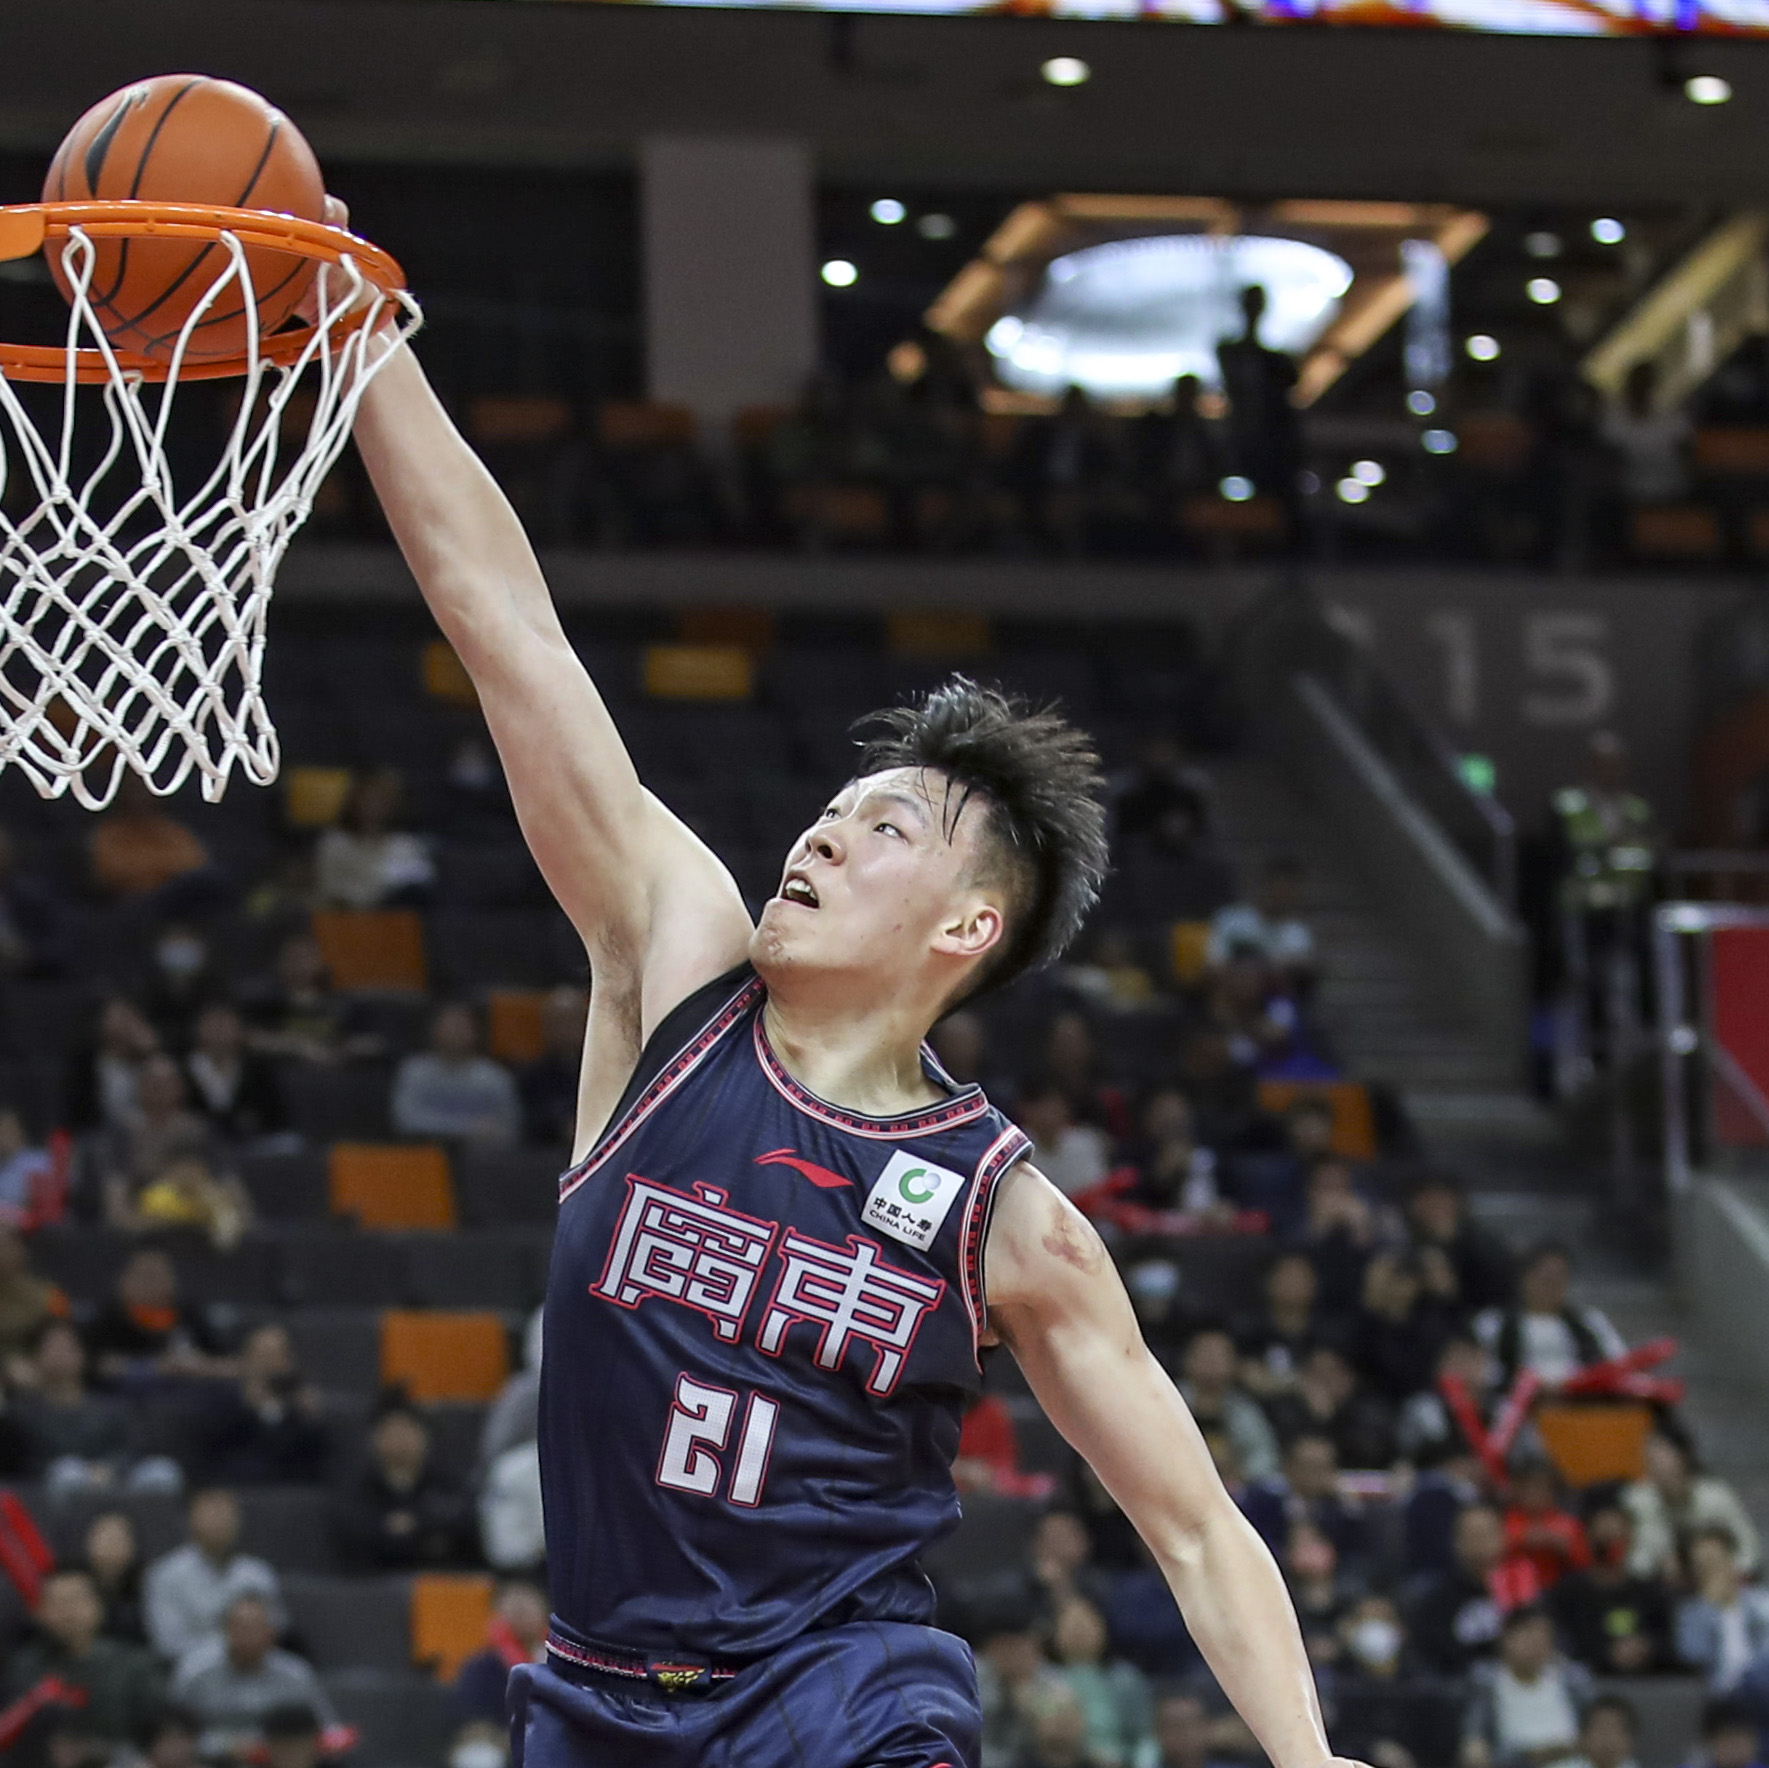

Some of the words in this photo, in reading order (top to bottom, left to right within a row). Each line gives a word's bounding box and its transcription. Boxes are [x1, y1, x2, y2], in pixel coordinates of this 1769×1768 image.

[869, 1208, 900, 1230] CHINA
[902, 1226, 927, 1242] LIFE
[873, 1196, 933, 1232] 中国人寿
[655, 1371, 780, 1508] 21
